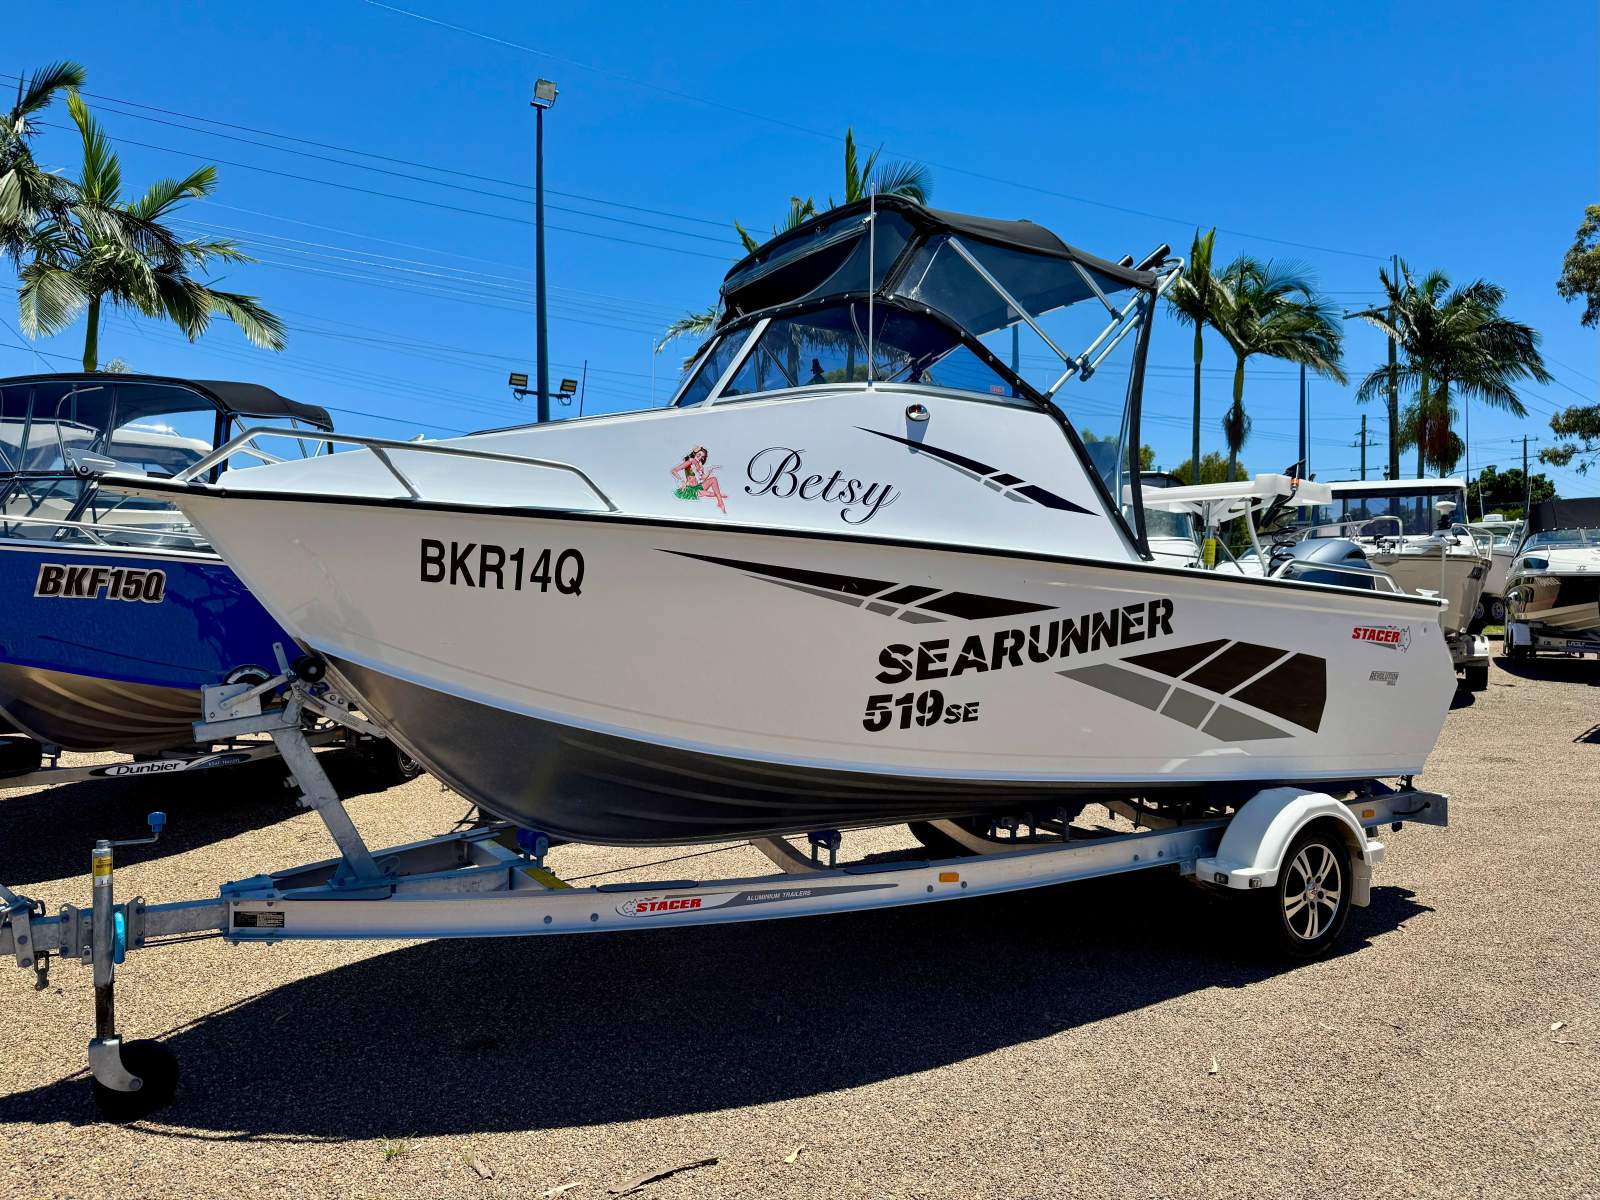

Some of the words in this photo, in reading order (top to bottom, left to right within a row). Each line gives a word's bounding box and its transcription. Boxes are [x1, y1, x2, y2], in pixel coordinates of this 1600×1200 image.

[744, 447, 901, 525] Betsy
[420, 538, 585, 597] BKR14Q
[874, 598, 1174, 684] SEARUNNER
[1351, 627, 1401, 643] STACER
[116, 761, 180, 775] Dunbier
[782, 889, 813, 898] TRAILERS
[636, 897, 702, 914] STACER
